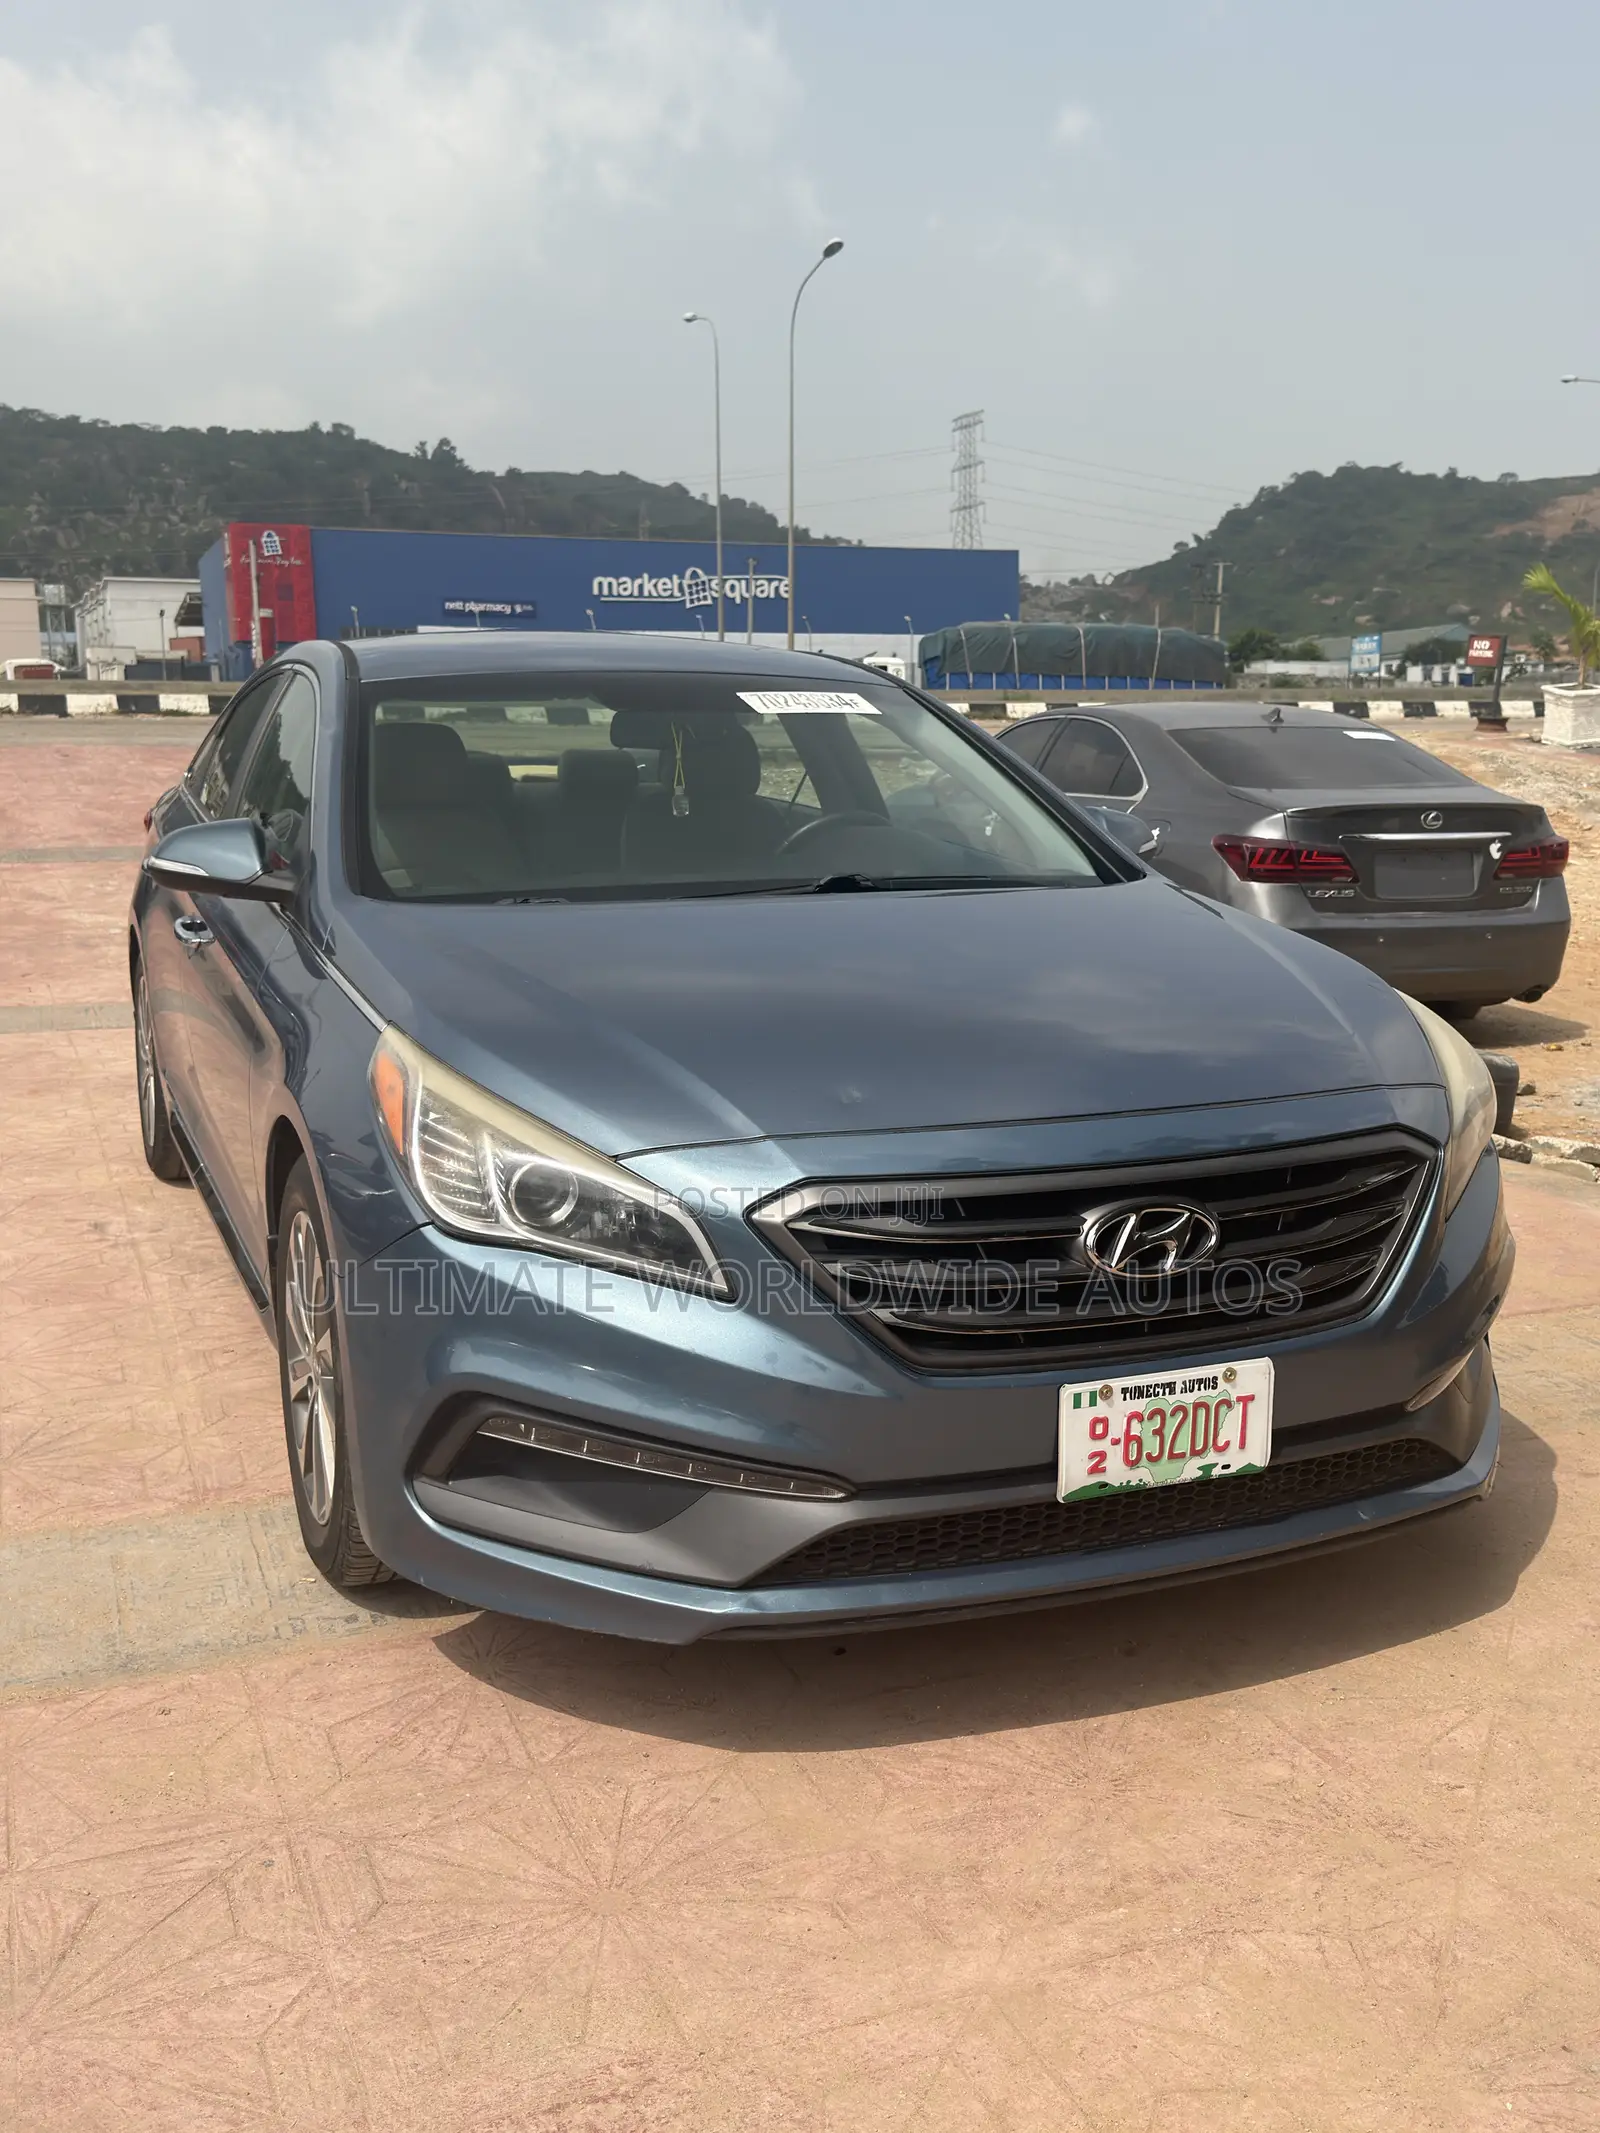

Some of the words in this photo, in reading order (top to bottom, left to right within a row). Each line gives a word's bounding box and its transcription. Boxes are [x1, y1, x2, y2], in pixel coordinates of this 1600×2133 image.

[592, 573, 682, 597] market
[710, 578, 792, 604] square
[464, 601, 512, 614] pharmacy
[1473, 640, 1490, 650] NO
[1307, 890, 1355, 898] LEXUS
[1180, 1376, 1219, 1394] AUTOS
